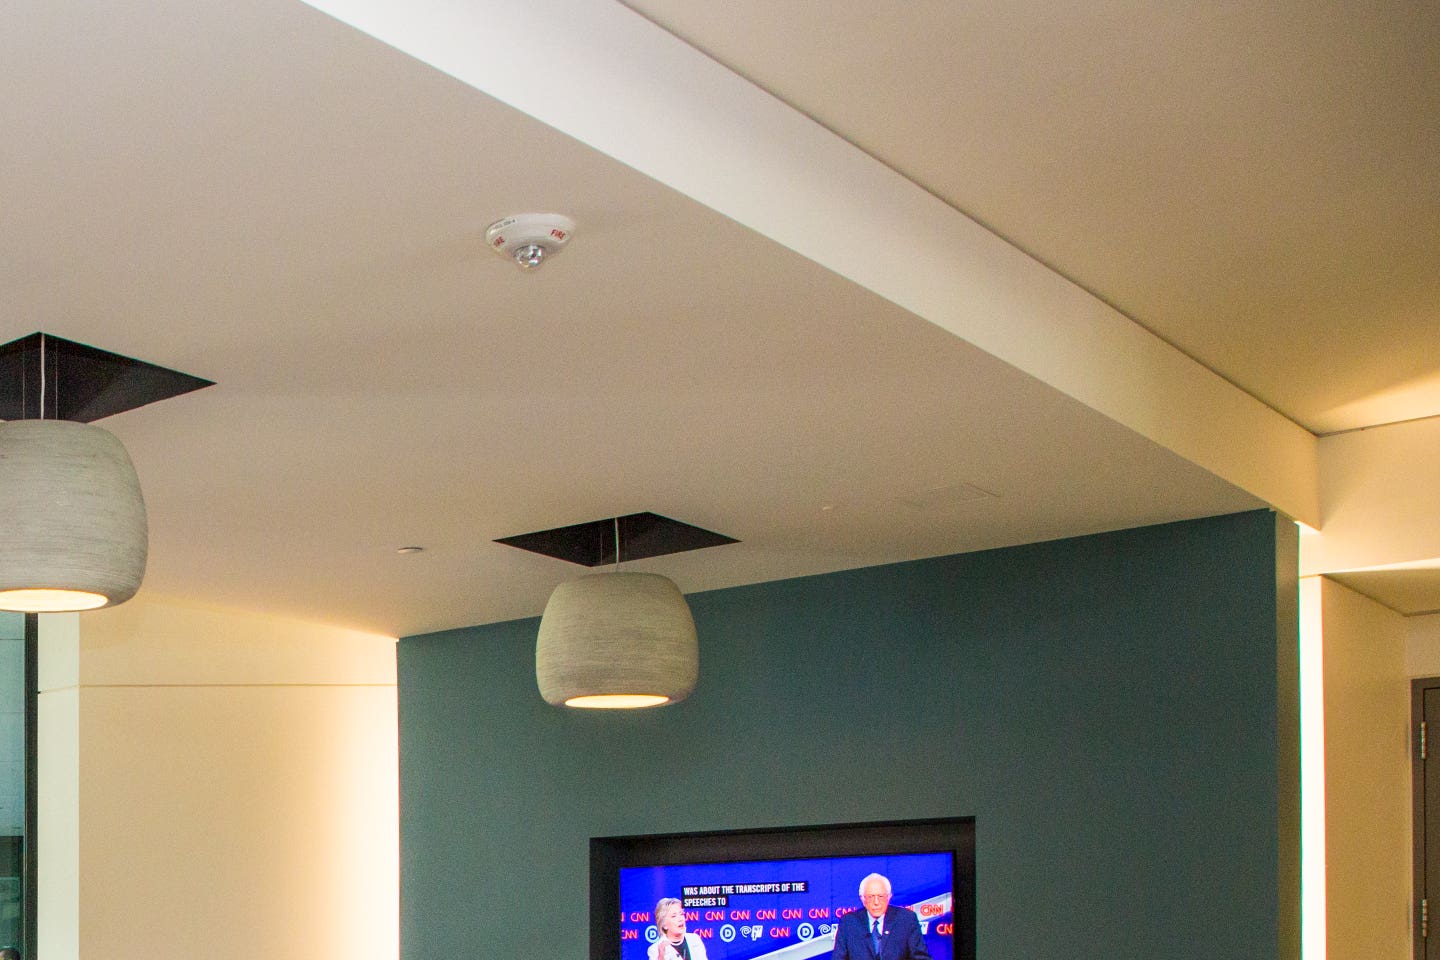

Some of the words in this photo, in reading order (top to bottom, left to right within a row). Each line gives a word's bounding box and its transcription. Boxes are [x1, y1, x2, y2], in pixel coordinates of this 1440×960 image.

[683, 887, 698, 895] WAS
[699, 886, 720, 895] ABOUT
[721, 885, 734, 894] THE
[735, 883, 780, 894] TRANSCRIPTS
[781, 883, 791, 892] OF
[792, 882, 805, 891] THE
[683, 897, 716, 907] SPEECHES
[717, 897, 726, 906] TO
[630, 912, 649, 922] CNN
[705, 911, 724, 920] CNN
[730, 910, 750, 920] CNN
[756, 909, 776, 920] CNN
[782, 908, 802, 919] CNN
[808, 907, 829, 918] CNN
[920, 904, 944, 916] CNN
[769, 927, 790, 938] CNN
[936, 924, 953, 935] CN
